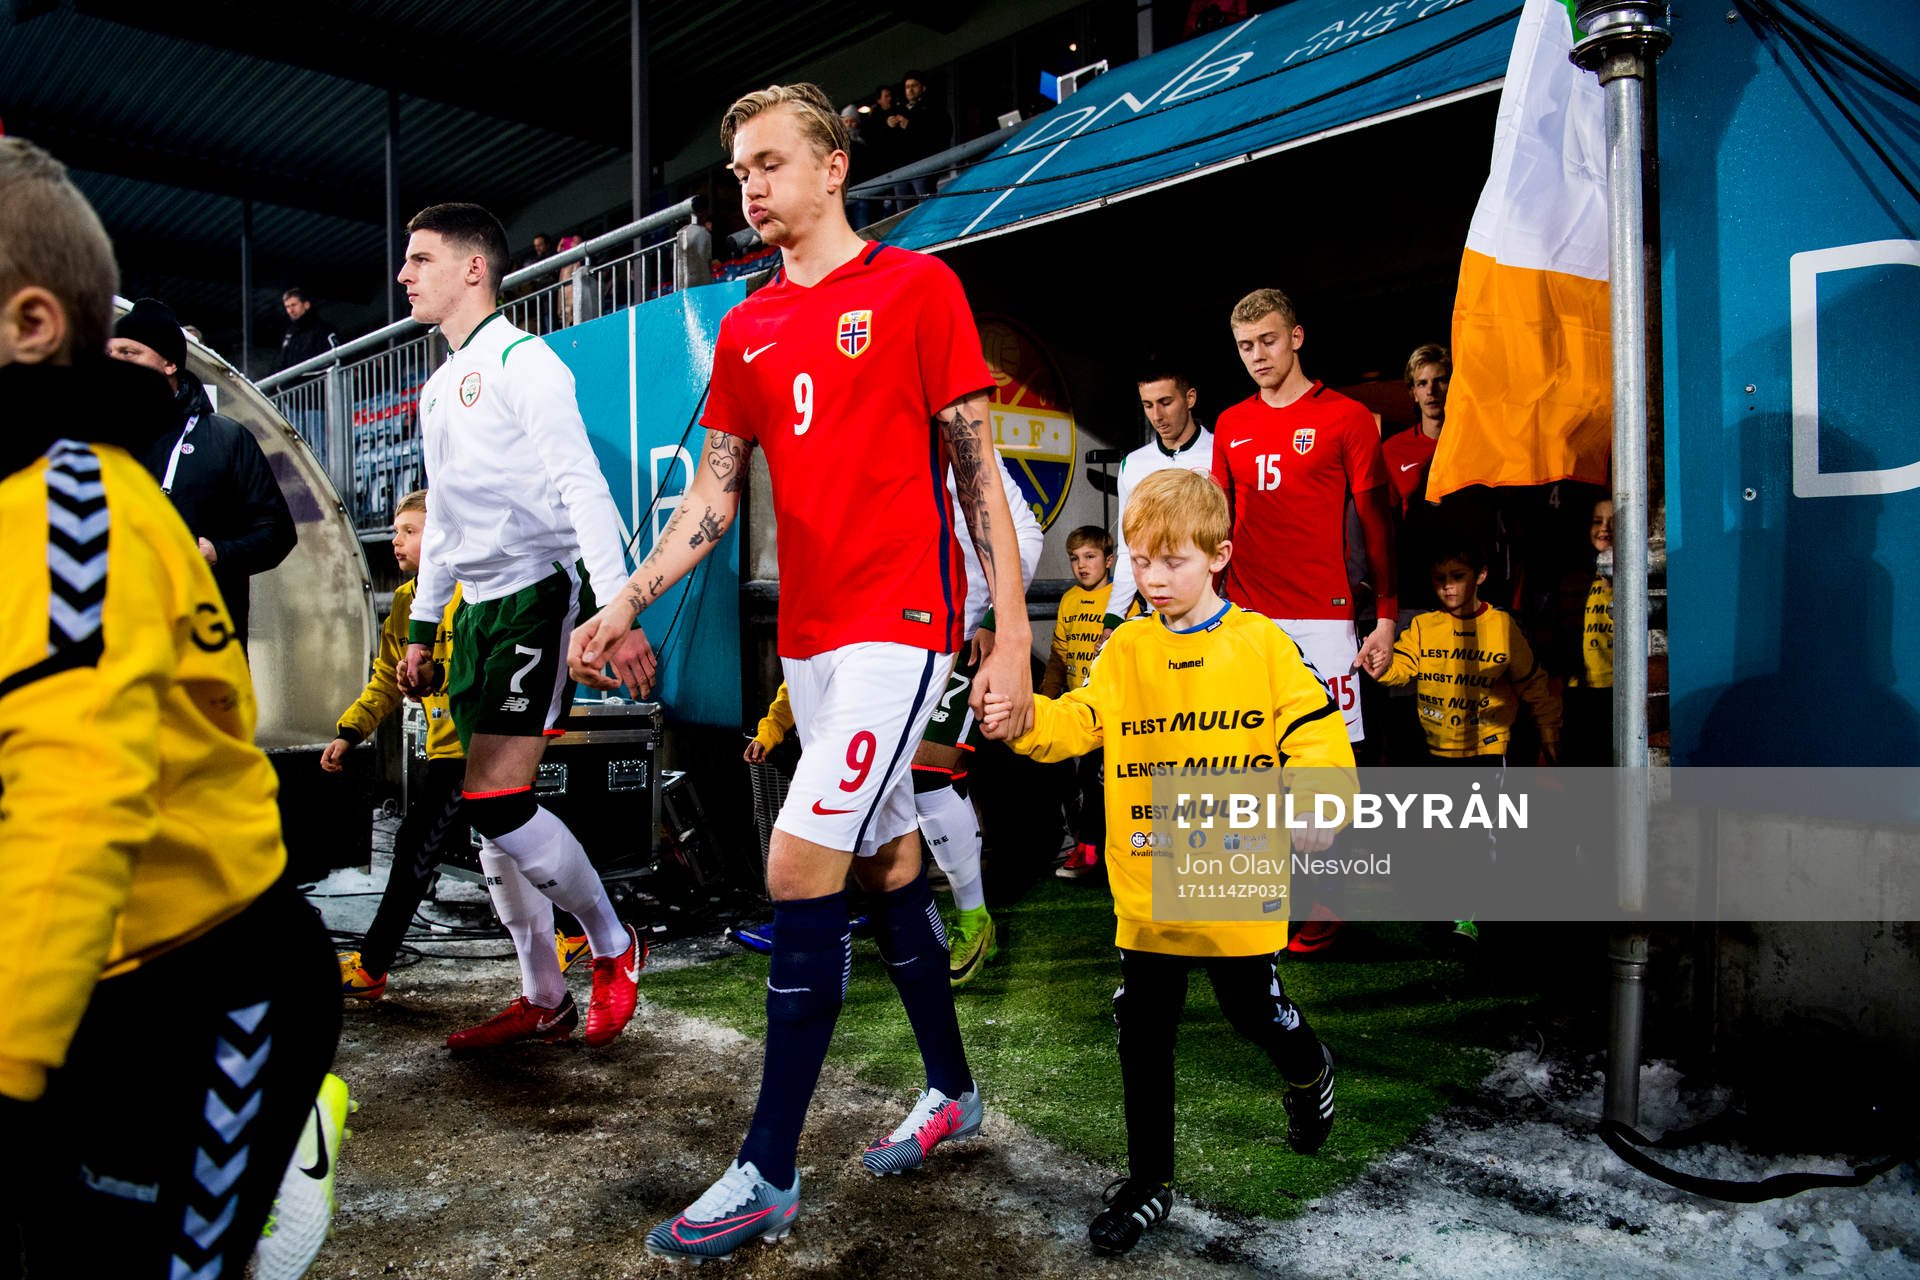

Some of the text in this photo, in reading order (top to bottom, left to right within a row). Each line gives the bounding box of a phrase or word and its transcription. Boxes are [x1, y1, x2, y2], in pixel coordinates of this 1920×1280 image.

[793, 373, 814, 436] 9
[1255, 454, 1282, 491] 15
[1586, 623, 1614, 633] MUL
[510, 644, 543, 694] 7
[1168, 657, 1204, 670] hummel
[1420, 648, 1508, 664] LEST MULIG
[941, 671, 970, 710] 7
[1327, 674, 1355, 711] 15
[1417, 672, 1496, 689] ENGST MULI
[1121, 710, 1265, 736] FLEST MULIG
[839, 731, 877, 793] 9
[1116, 754, 1275, 779] LENGST MULIG
[1131, 804, 1168, 820] BEST
